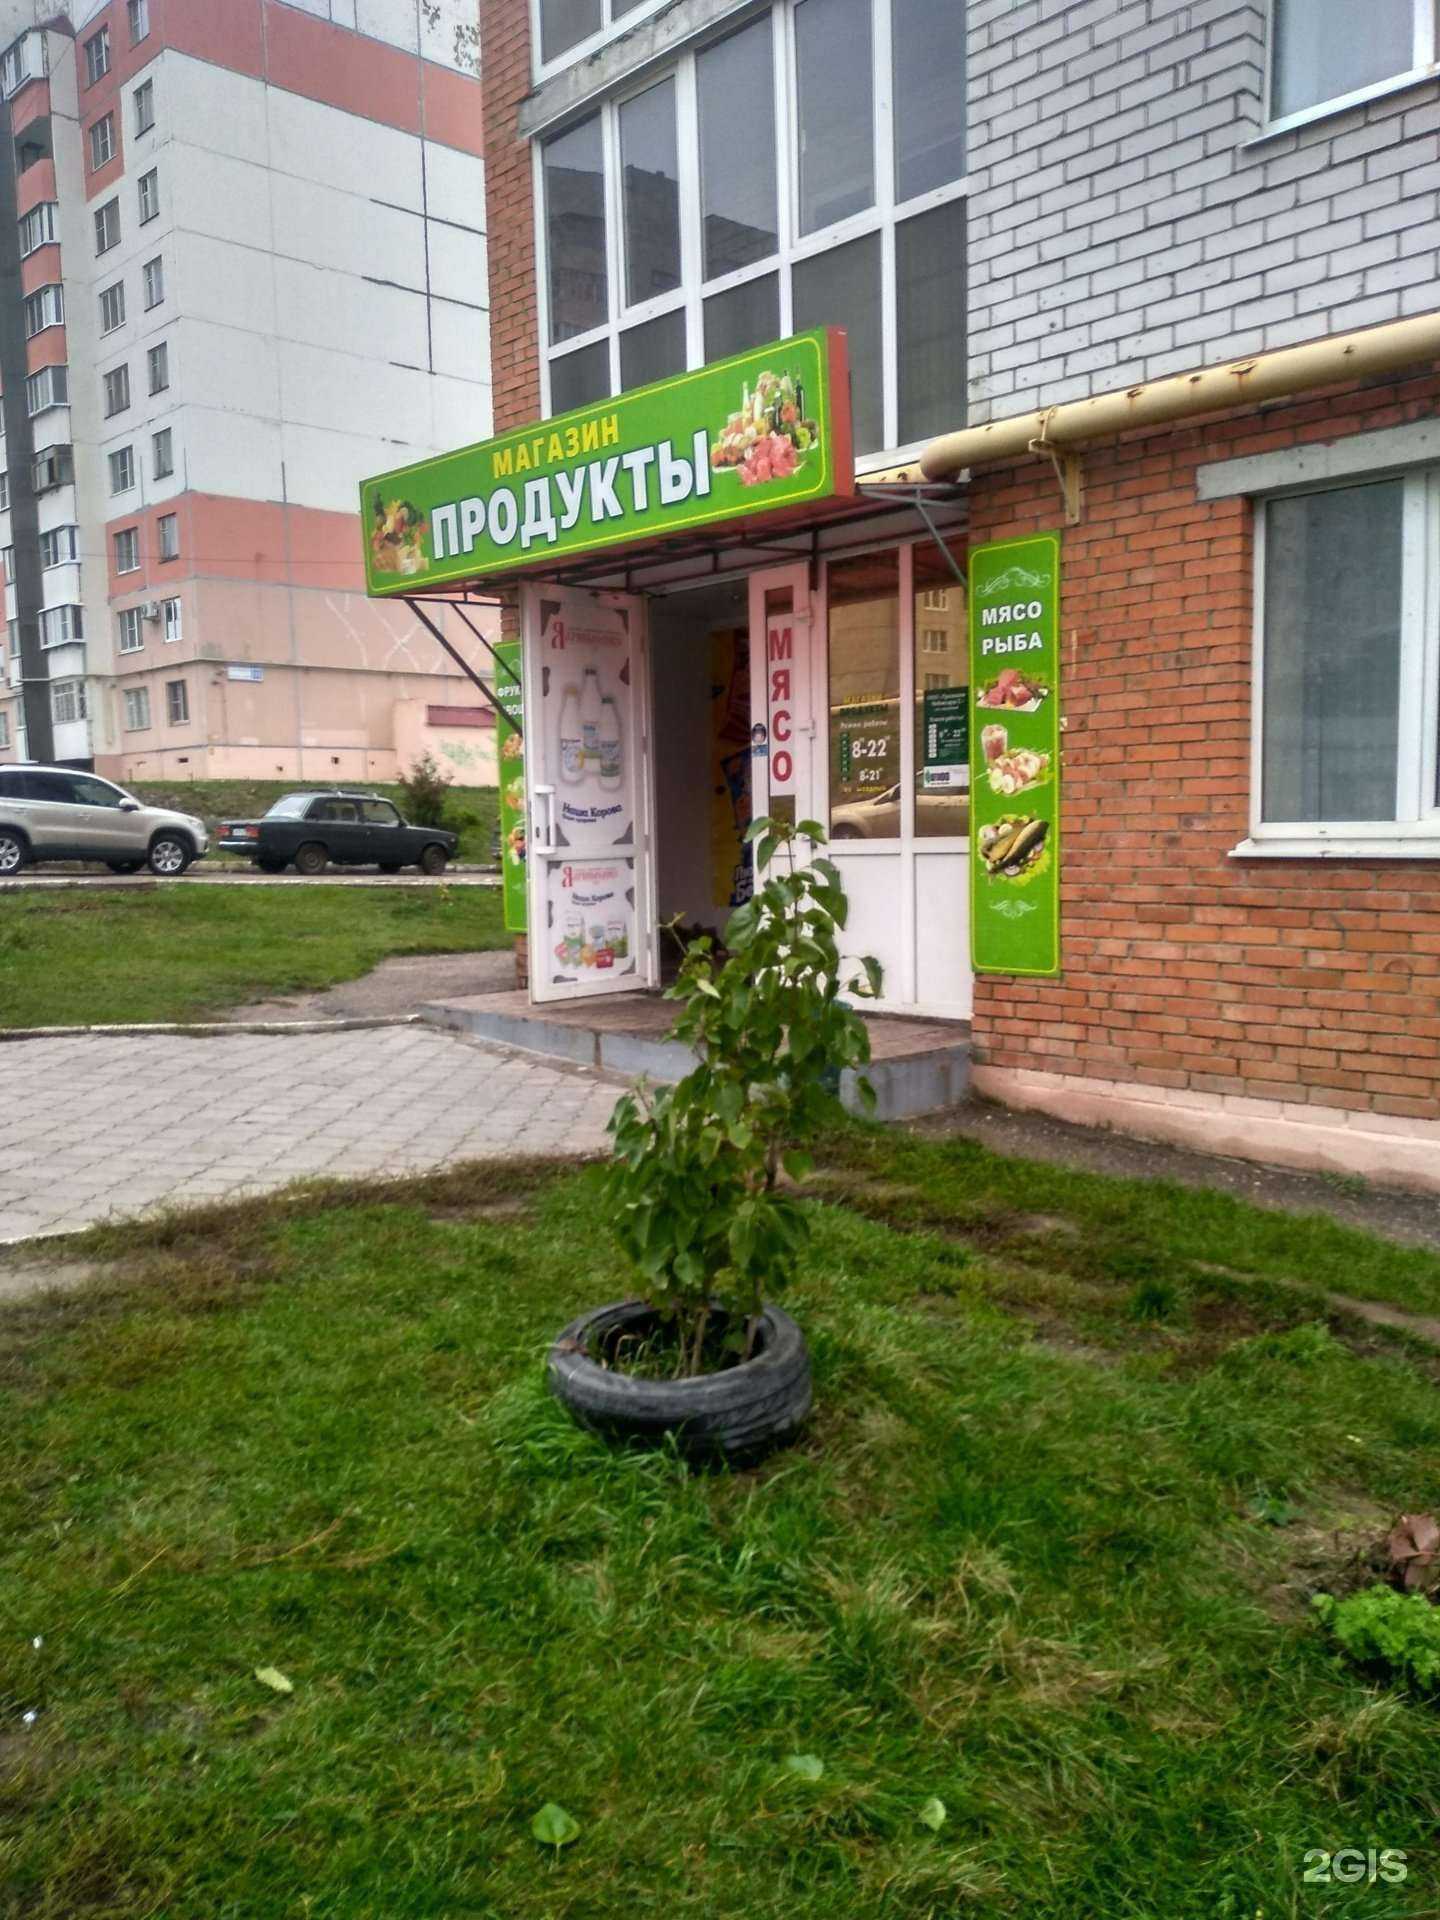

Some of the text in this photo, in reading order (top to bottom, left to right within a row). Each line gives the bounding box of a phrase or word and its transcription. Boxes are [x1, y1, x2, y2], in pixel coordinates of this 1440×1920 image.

[492, 414, 619, 478] МАГАЗИН
[431, 430, 712, 560] ПРОДУКТЫ
[982, 601, 1042, 626] МЯСО
[982, 632, 1043, 655] РЫБА
[769, 627, 792, 783] МЯСО
